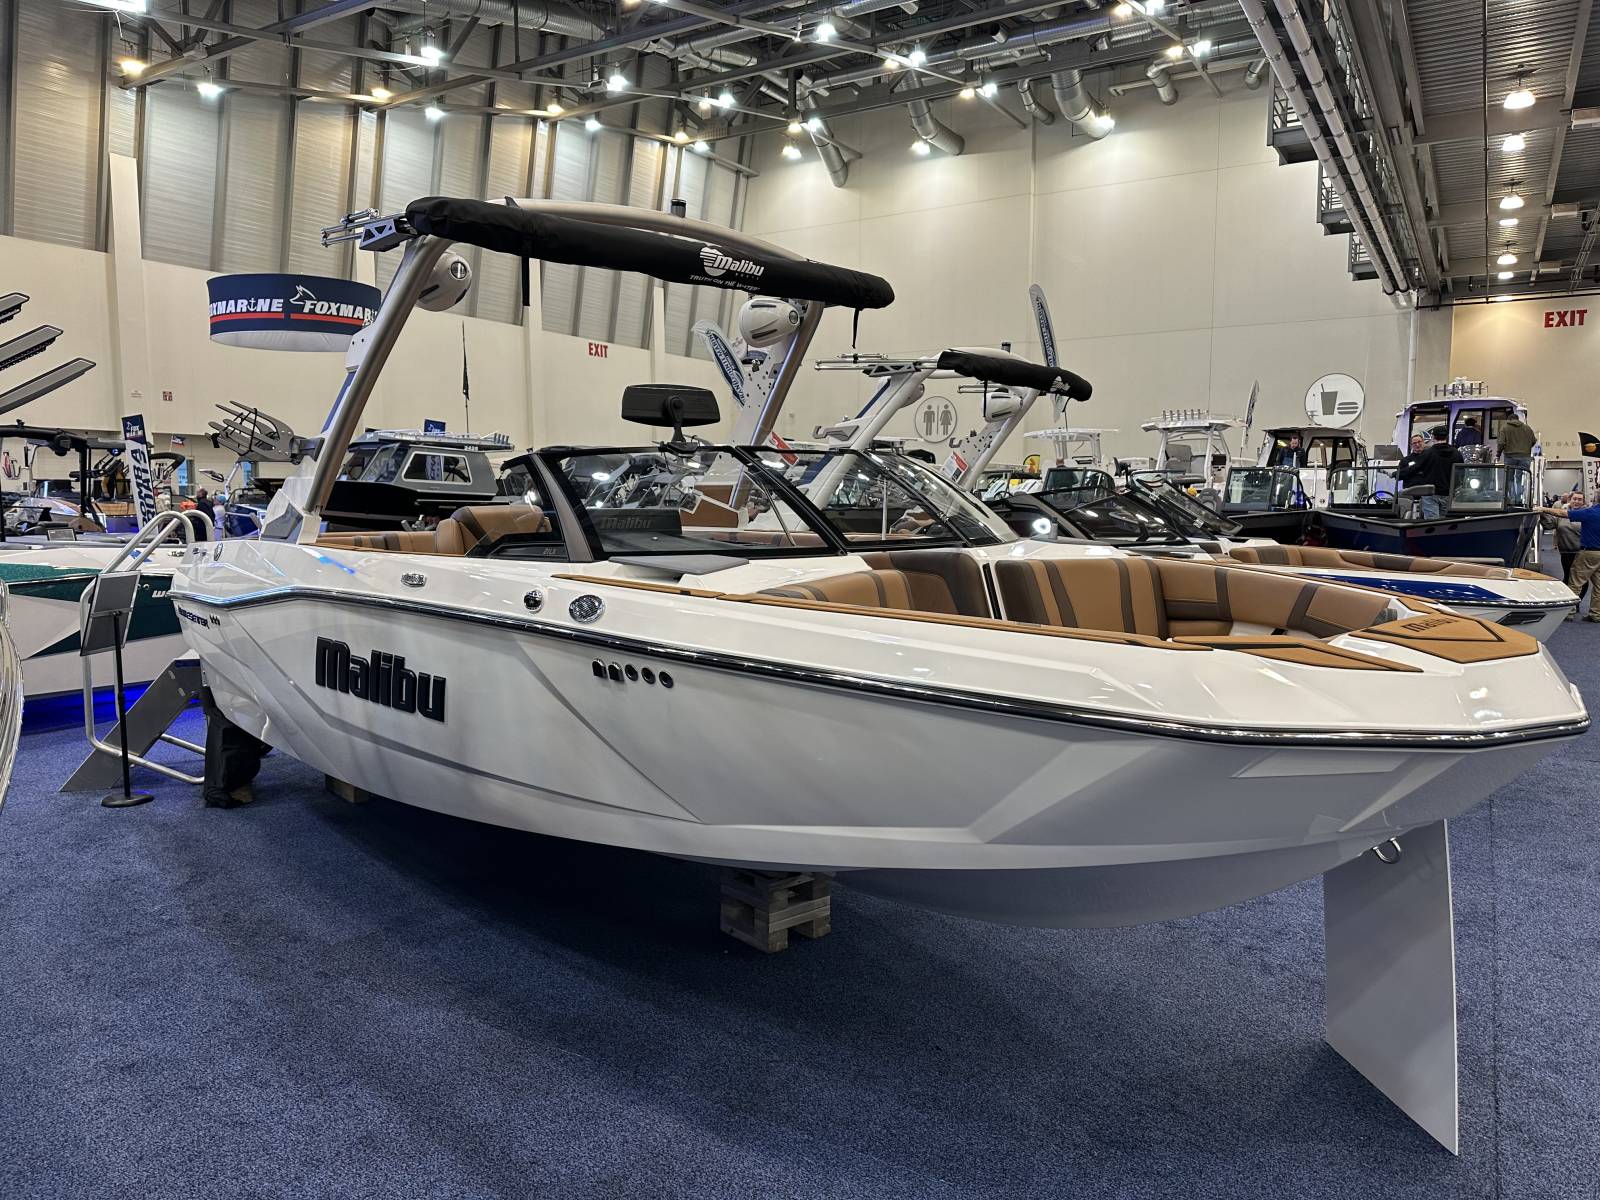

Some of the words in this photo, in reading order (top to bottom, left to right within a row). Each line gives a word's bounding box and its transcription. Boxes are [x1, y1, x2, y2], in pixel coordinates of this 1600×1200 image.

[712, 255, 765, 277] Malibu
[303, 300, 378, 320] FOXMAR
[1544, 309, 1588, 328] EXIT
[588, 342, 608, 358] EXIT
[315, 636, 447, 723] Malibu
